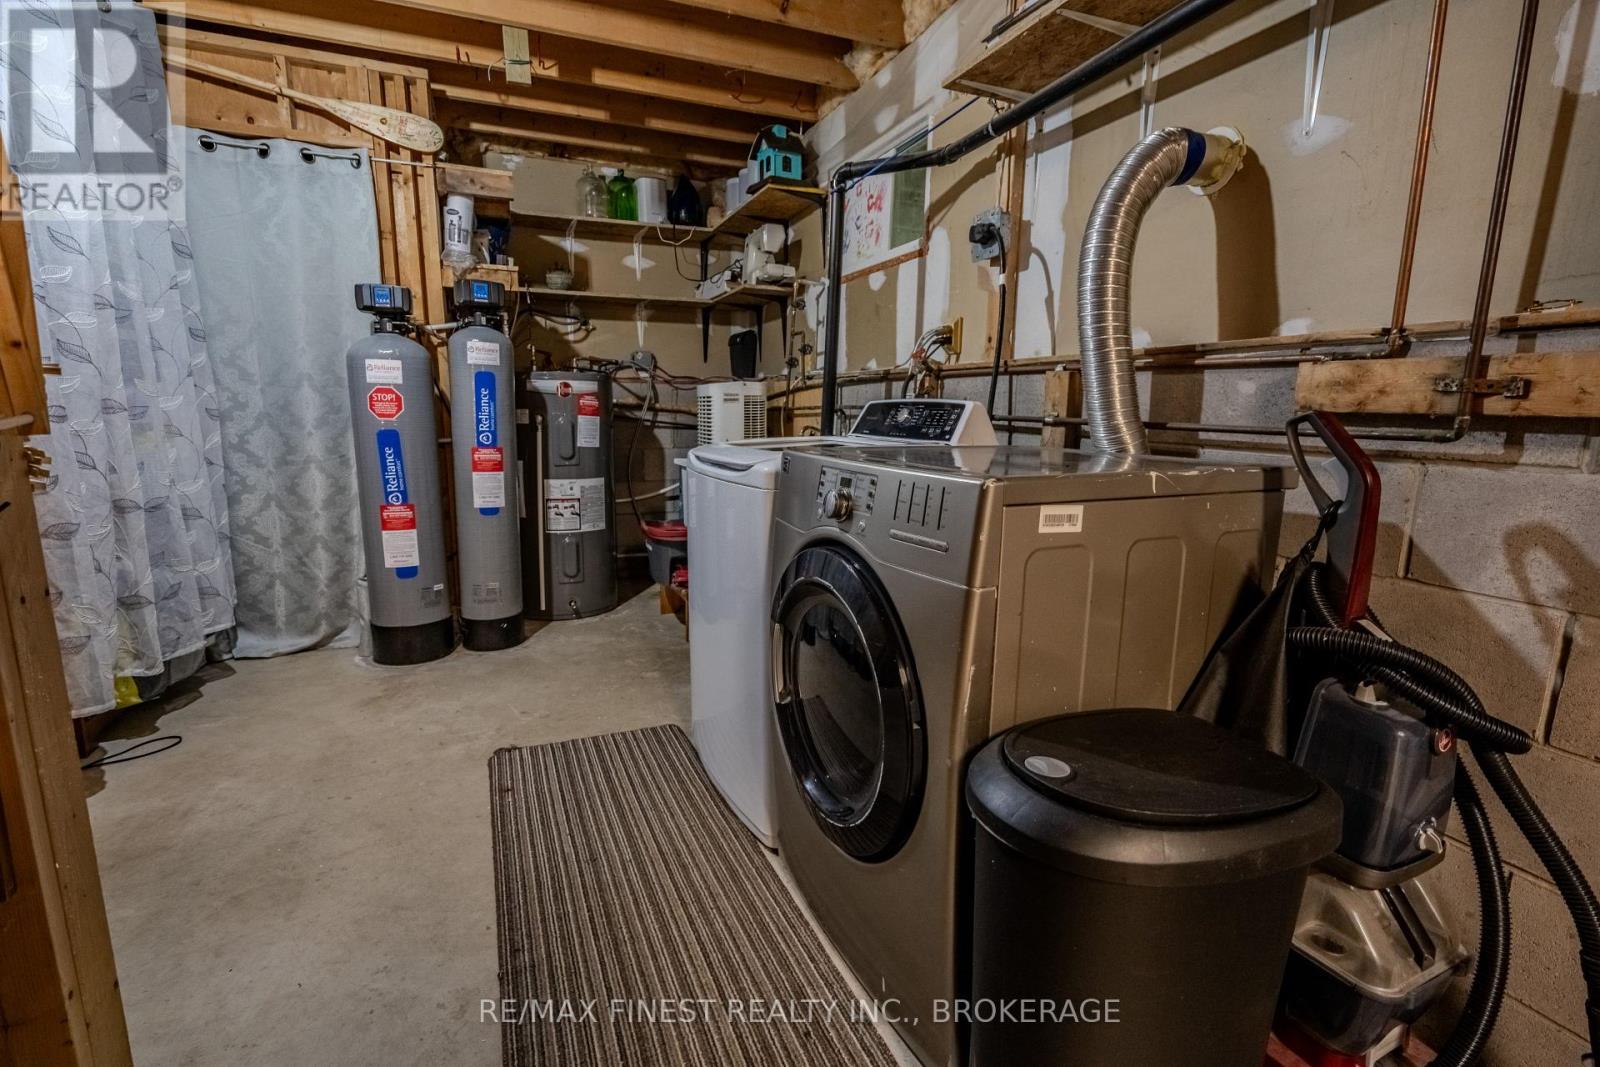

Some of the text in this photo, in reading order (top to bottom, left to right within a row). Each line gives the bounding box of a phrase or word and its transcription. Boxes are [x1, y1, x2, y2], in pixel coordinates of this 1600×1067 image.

[372, 393, 396, 401] STOP!
[478, 387, 489, 431] Reliance
[384, 446, 398, 491] Reliance
